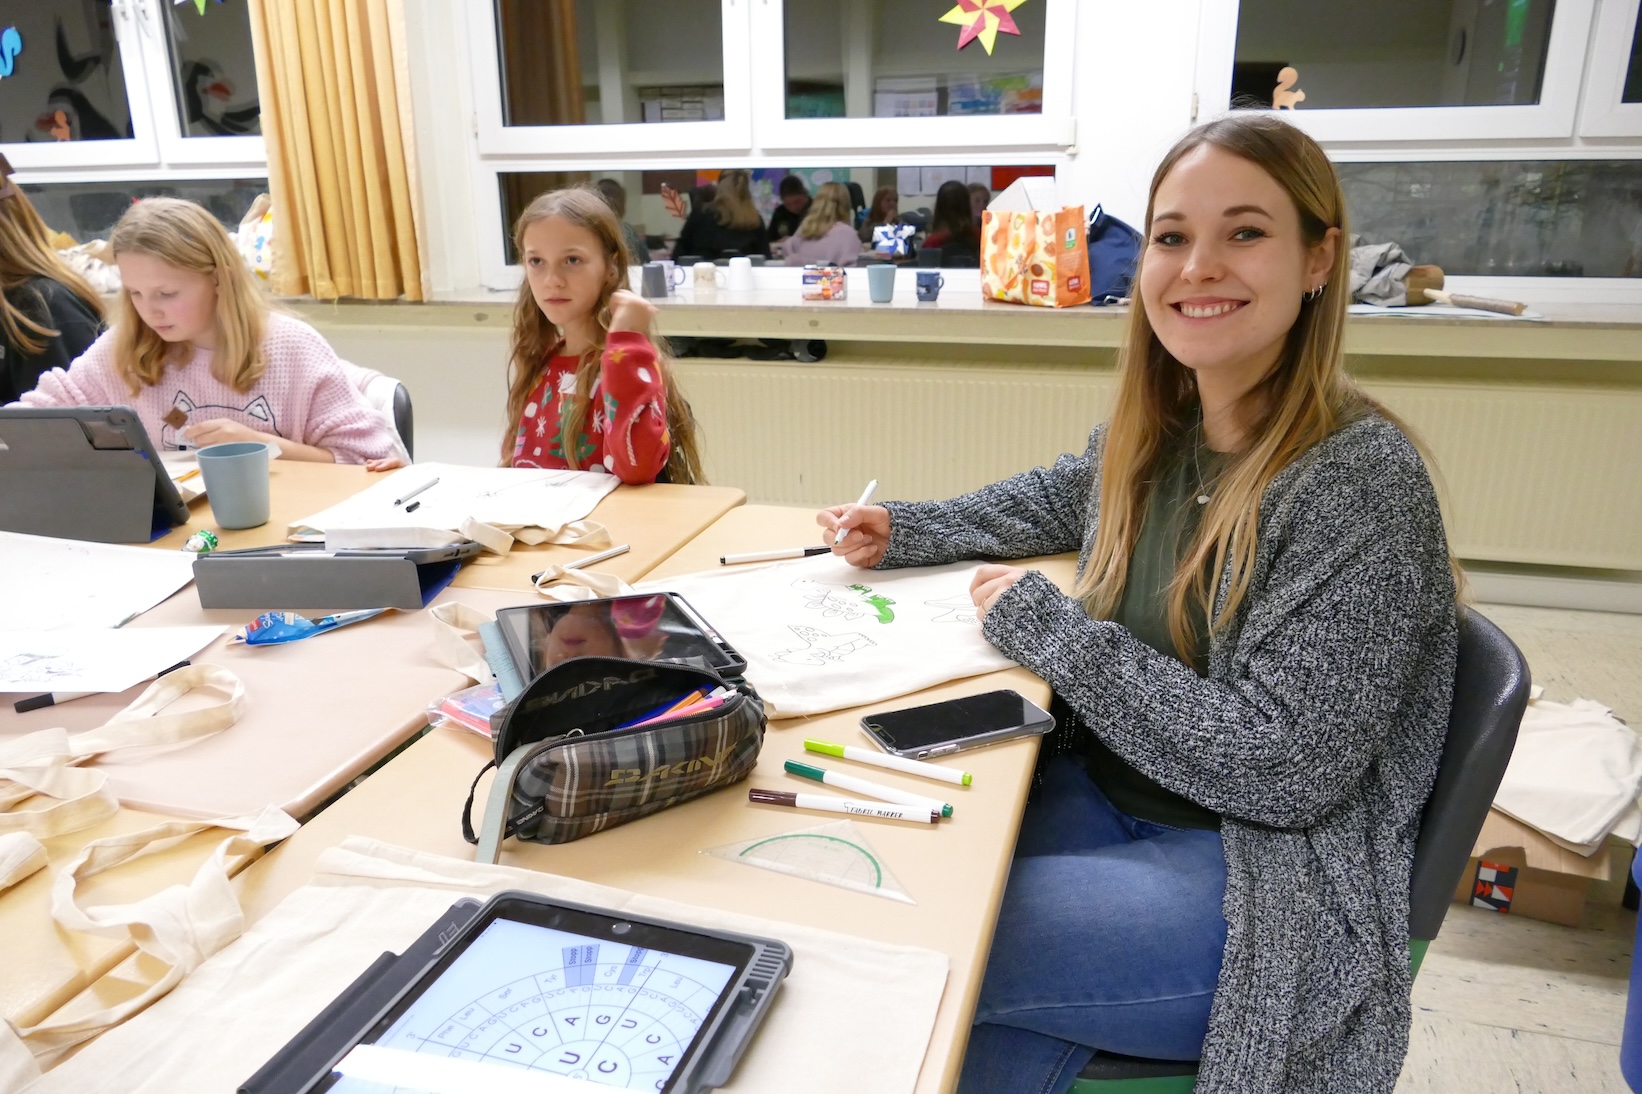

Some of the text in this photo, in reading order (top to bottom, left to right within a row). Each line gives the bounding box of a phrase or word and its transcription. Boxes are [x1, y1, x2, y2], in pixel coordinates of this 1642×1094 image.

[604, 741, 738, 787] DAKIN
[569, 948, 578, 965] Stopp
[584, 946, 594, 963] Stopp
[638, 967, 651, 977] Trp
[505, 1015, 611, 1053] U C A G
[621, 1019, 638, 1029] U
[646, 1034, 661, 1044] C
[657, 1055, 674, 1066] A
[559, 1051, 580, 1065] U
[597, 1060, 618, 1074] C
